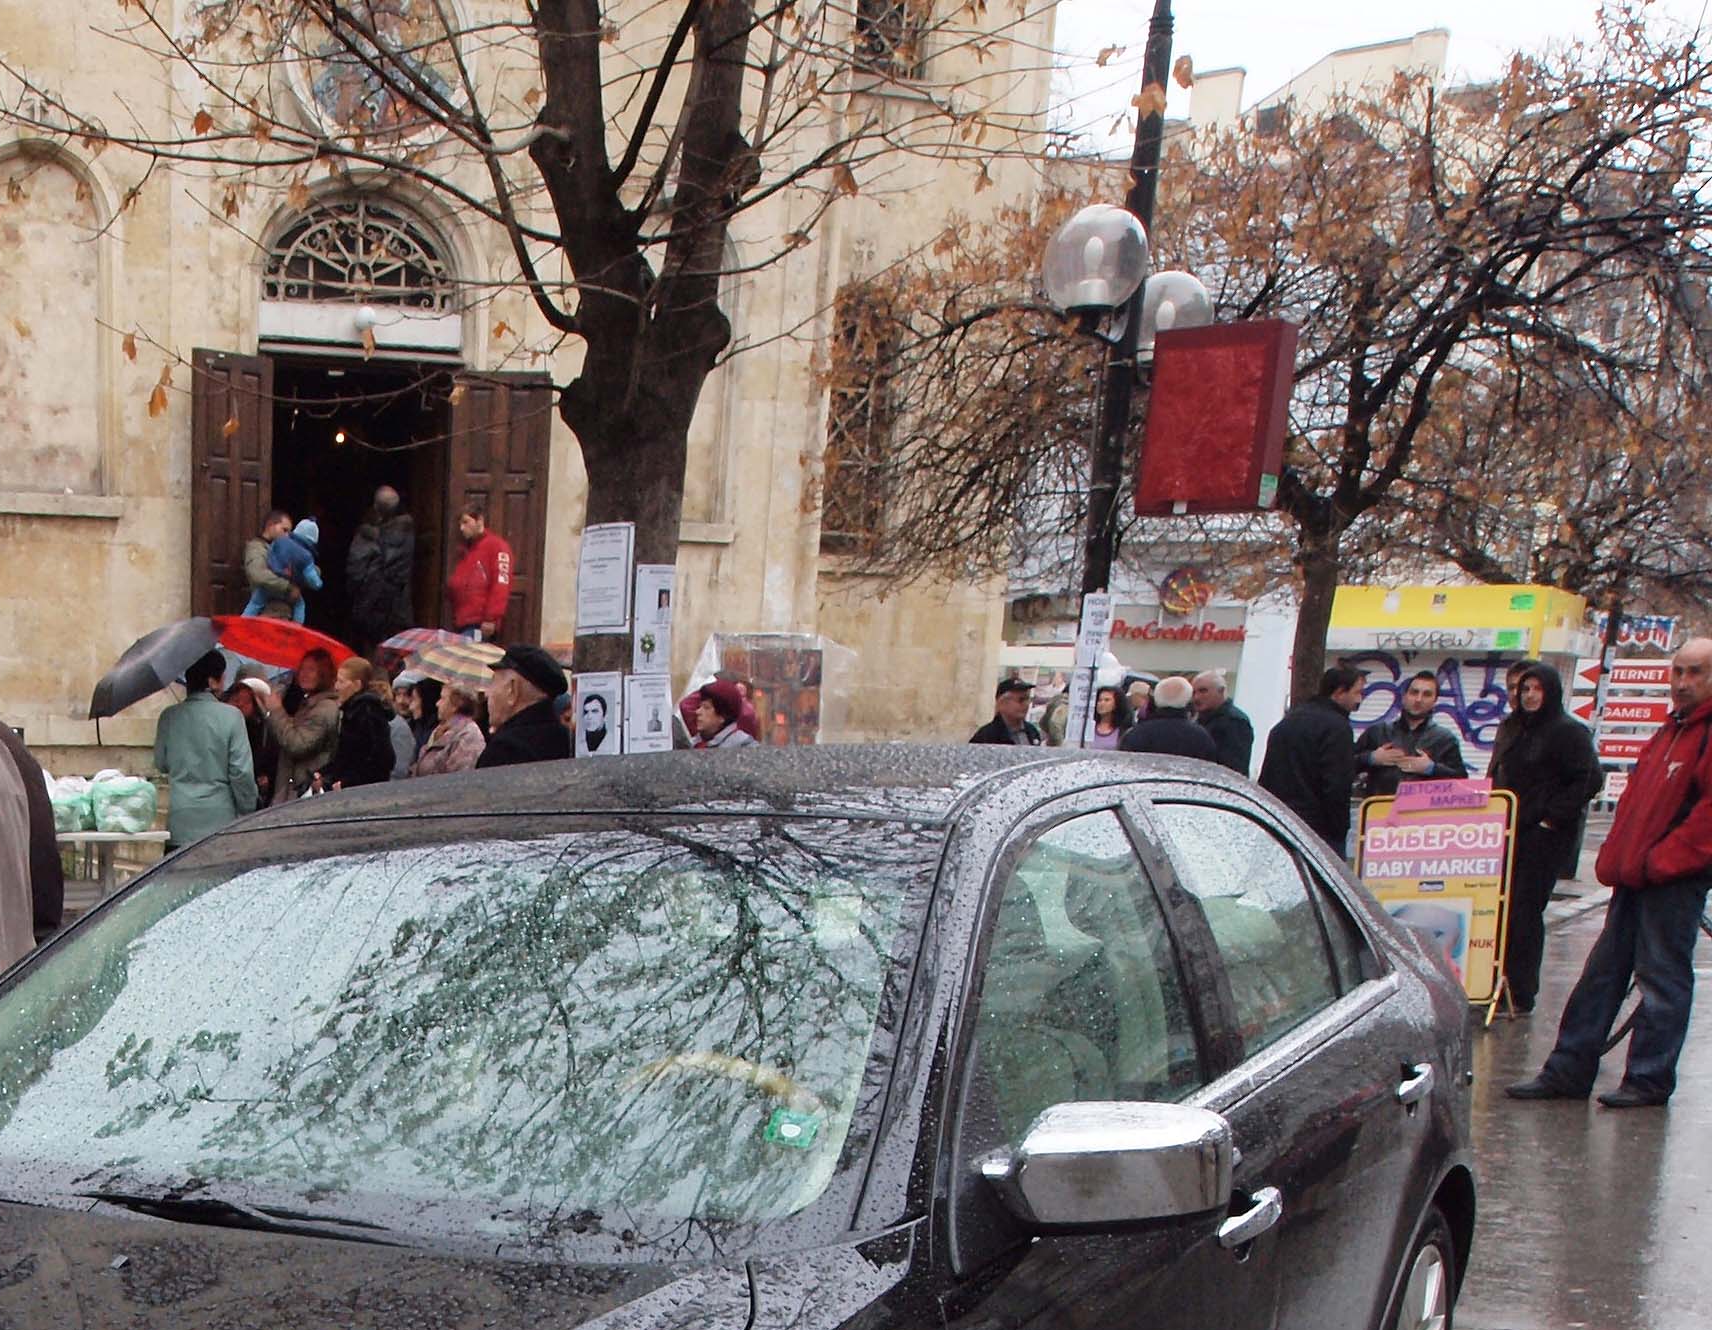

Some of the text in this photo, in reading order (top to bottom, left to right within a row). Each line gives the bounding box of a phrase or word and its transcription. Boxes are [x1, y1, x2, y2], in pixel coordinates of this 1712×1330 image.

[1110, 618, 1197, 641] ProCredit
[1200, 621, 1247, 642] Bank
[1613, 668, 1665, 681] TERNET
[1398, 782, 1453, 796] ДЕТСКИ
[1430, 793, 1484, 808] МАРКЕТ
[1367, 822, 1504, 852] БИБЕРОН
[1365, 858, 1499, 877] BABY MARKET
[1469, 938, 1495, 949] NUK
